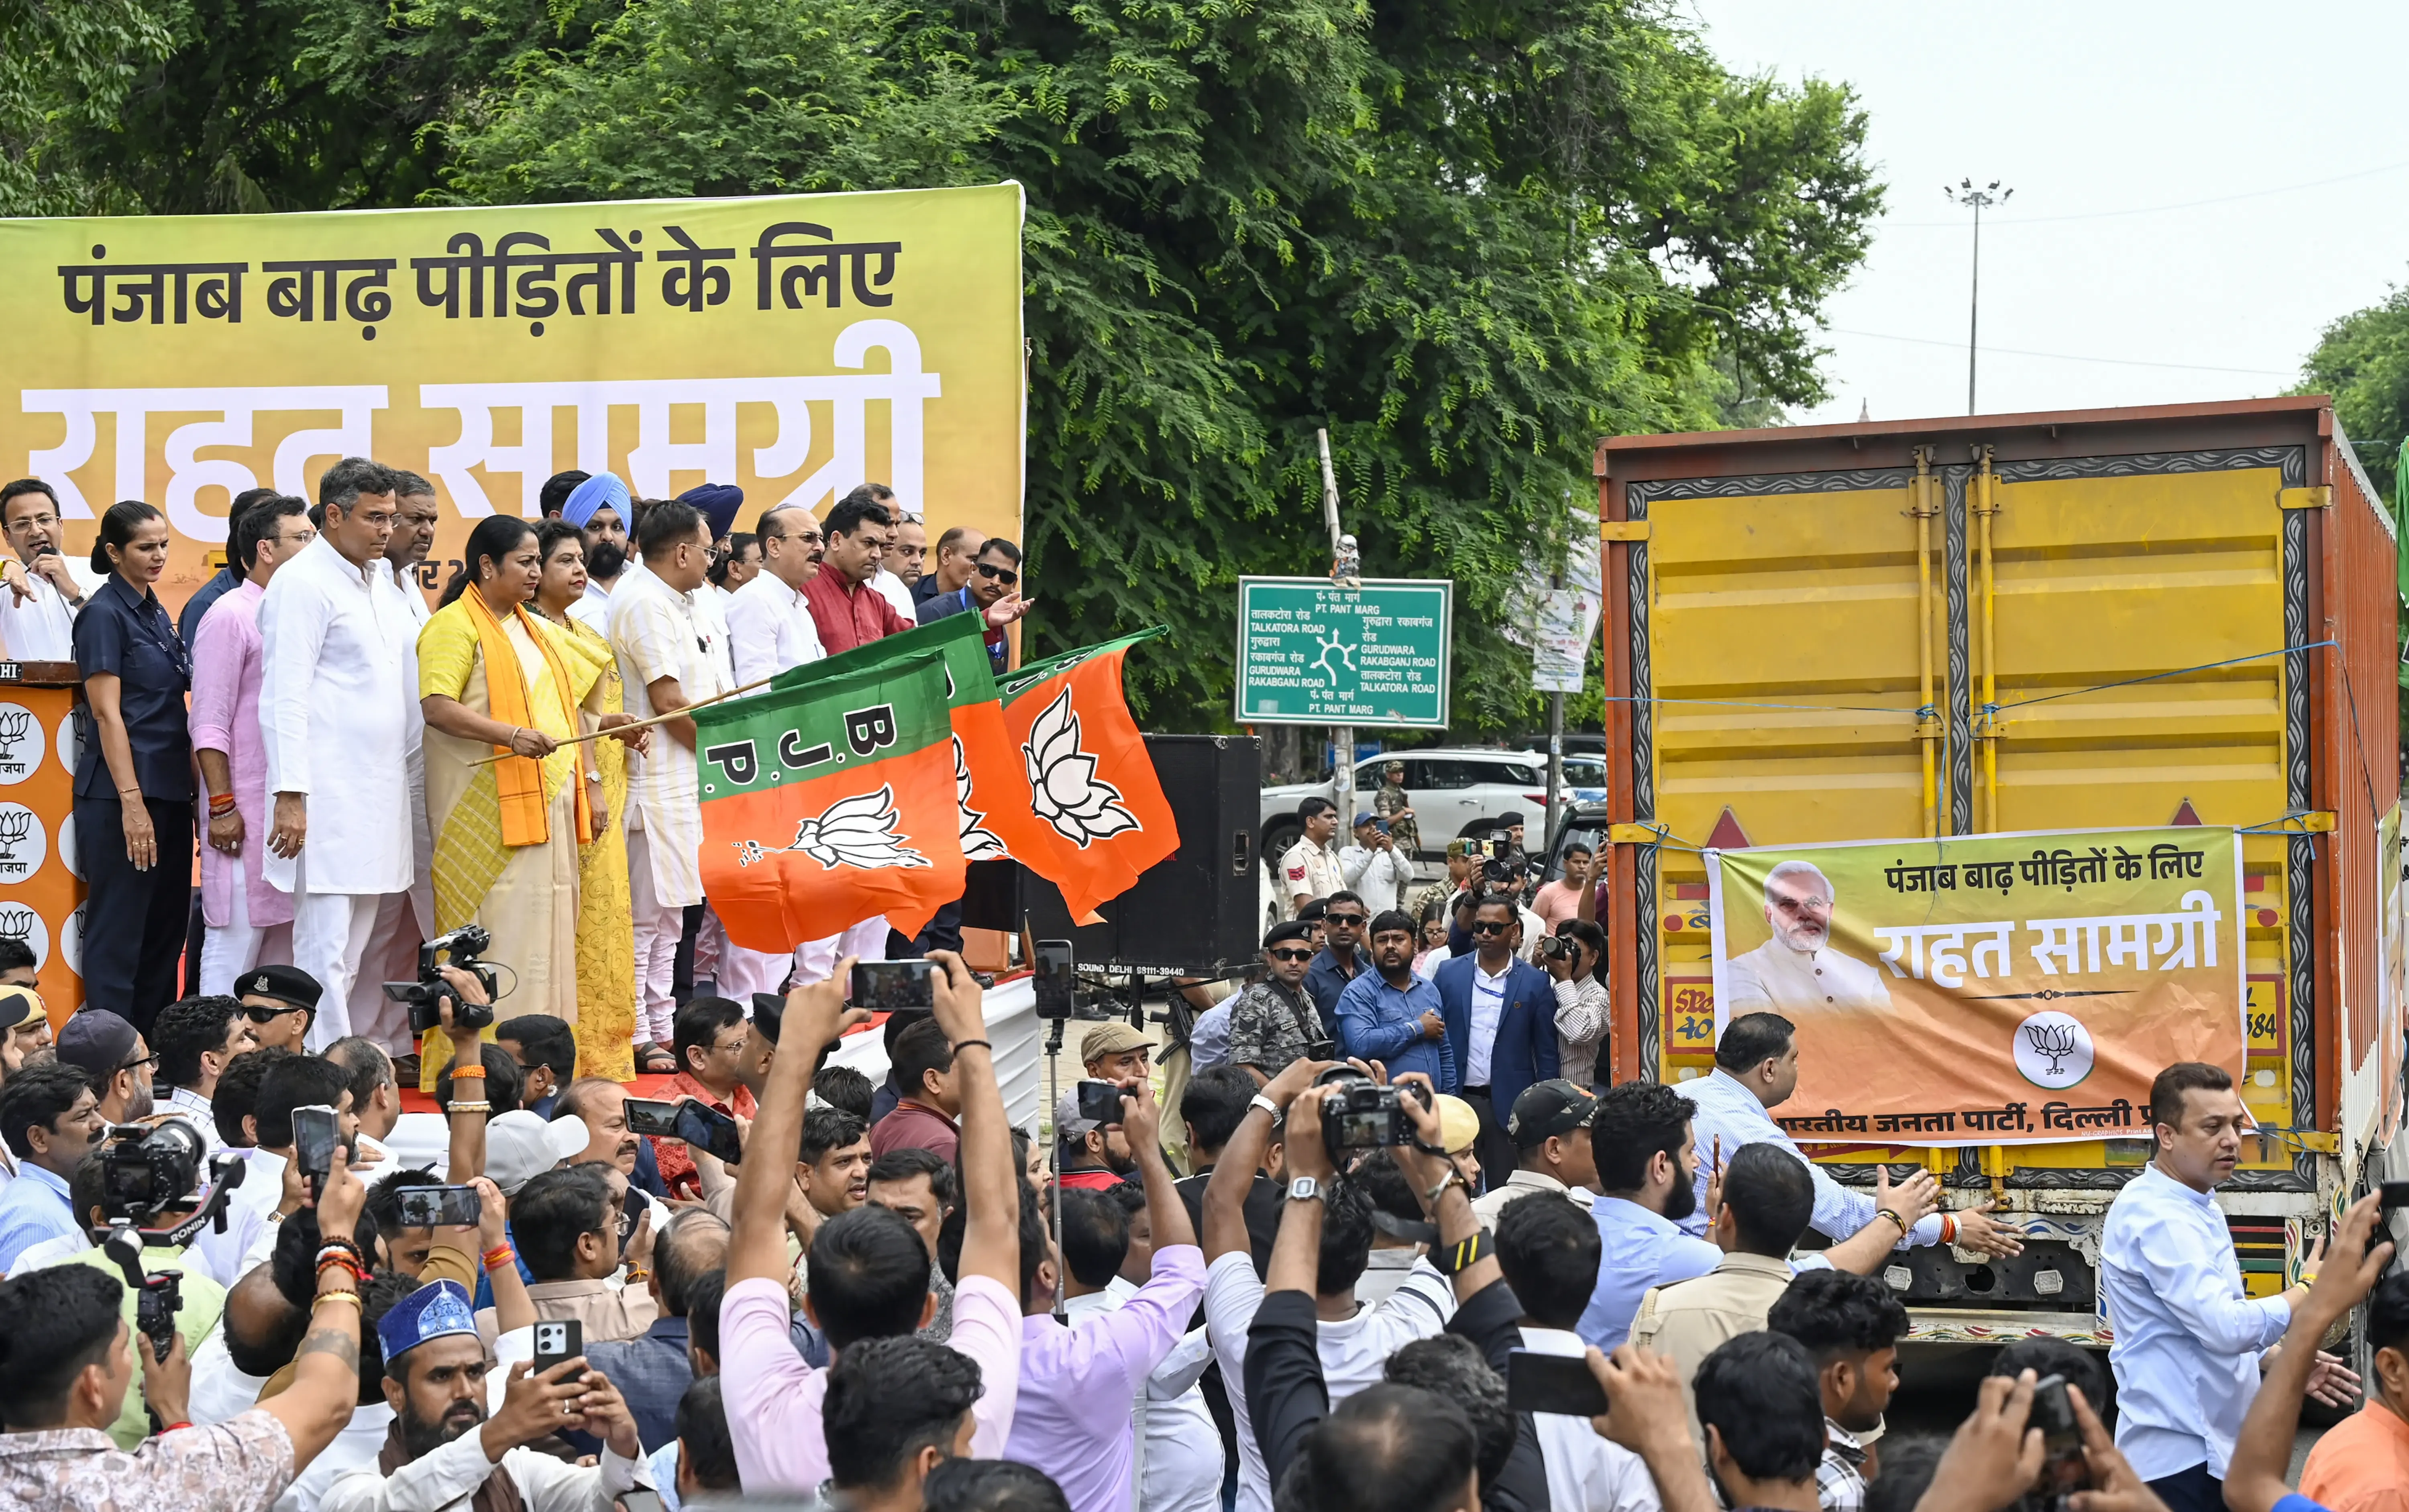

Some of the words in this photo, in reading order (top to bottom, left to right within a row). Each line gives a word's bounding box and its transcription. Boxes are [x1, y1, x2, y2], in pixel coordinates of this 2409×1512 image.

[59, 245, 247, 326] पंजाब
[262, 258, 396, 340] बाढ़
[410, 230, 644, 337] पीड़ितों
[657, 226, 735, 312] के
[750, 222, 901, 311] लिए
[21, 385, 388, 544] राहत
[420, 318, 940, 518] सामग्री
[1328, 591, 1340, 602] पंत
[1345, 592, 1360, 603] मार्ग
[1251, 607, 1291, 620] तालकटोरा
[1296, 608, 1310, 620] रोड
[1316, 604, 1327, 613] PT.
[1330, 604, 1351, 614] PANT
[1355, 605, 1380, 615] MARG
[1251, 622, 1300, 633] TALKATORA
[1302, 624, 1325, 634] ROAD
[1363, 616, 1392, 629] गुरुद्वारा
[1362, 630, 1376, 642] रोड
[1250, 637, 1280, 650] गुरुद्वारा
[1361, 645, 1415, 655] GURUDWARA
[1290, 650, 1304, 663] रोड
[1360, 656, 1410, 667] RAKABGANJ
[1413, 658, 1436, 667] ROAD
[1249, 666, 1300, 676] GURUDWARA
[1361, 668, 1401, 681] तालकटोरा
[1406, 669, 1421, 681] रोड
[1249, 677, 1300, 687] RAKABGANJ
[1302, 678, 1325, 688] ROAD
[1360, 683, 1408, 692] TALKATORA
[1412, 684, 1435, 693] ROAD
[1322, 690, 1334, 701] पंत
[1339, 689, 1354, 701] मार्ग
[1309, 704, 1321, 713] PT.
[1324, 704, 1345, 714] PANT
[1349, 705, 1373, 715] MARG
[0, 763, 26, 774] ाजपा
[0, 862, 28, 874] ाजपा
[1885, 860, 1957, 893] पंजाब
[1963, 861, 2014, 896] बाढ़
[2019, 847, 2107, 892] पीड़ितों
[2113, 846, 2142, 880] के
[2148, 844, 2204, 880] लिए
[1873, 921, 2015, 988] राहत
[2026, 890, 2221, 975] सामग्री
[1078, 964, 1105, 972] SOUND
[1109, 965, 1132, 974] DELHI
[1675, 1015, 1714, 1040] 40
[1873, 1113, 1955, 1132] जनता
[1961, 1102, 2034, 1133] पार्टी,
[2040, 1099, 2132, 1131] दिल्ली
[170, 1216, 206, 1244] RONIN
